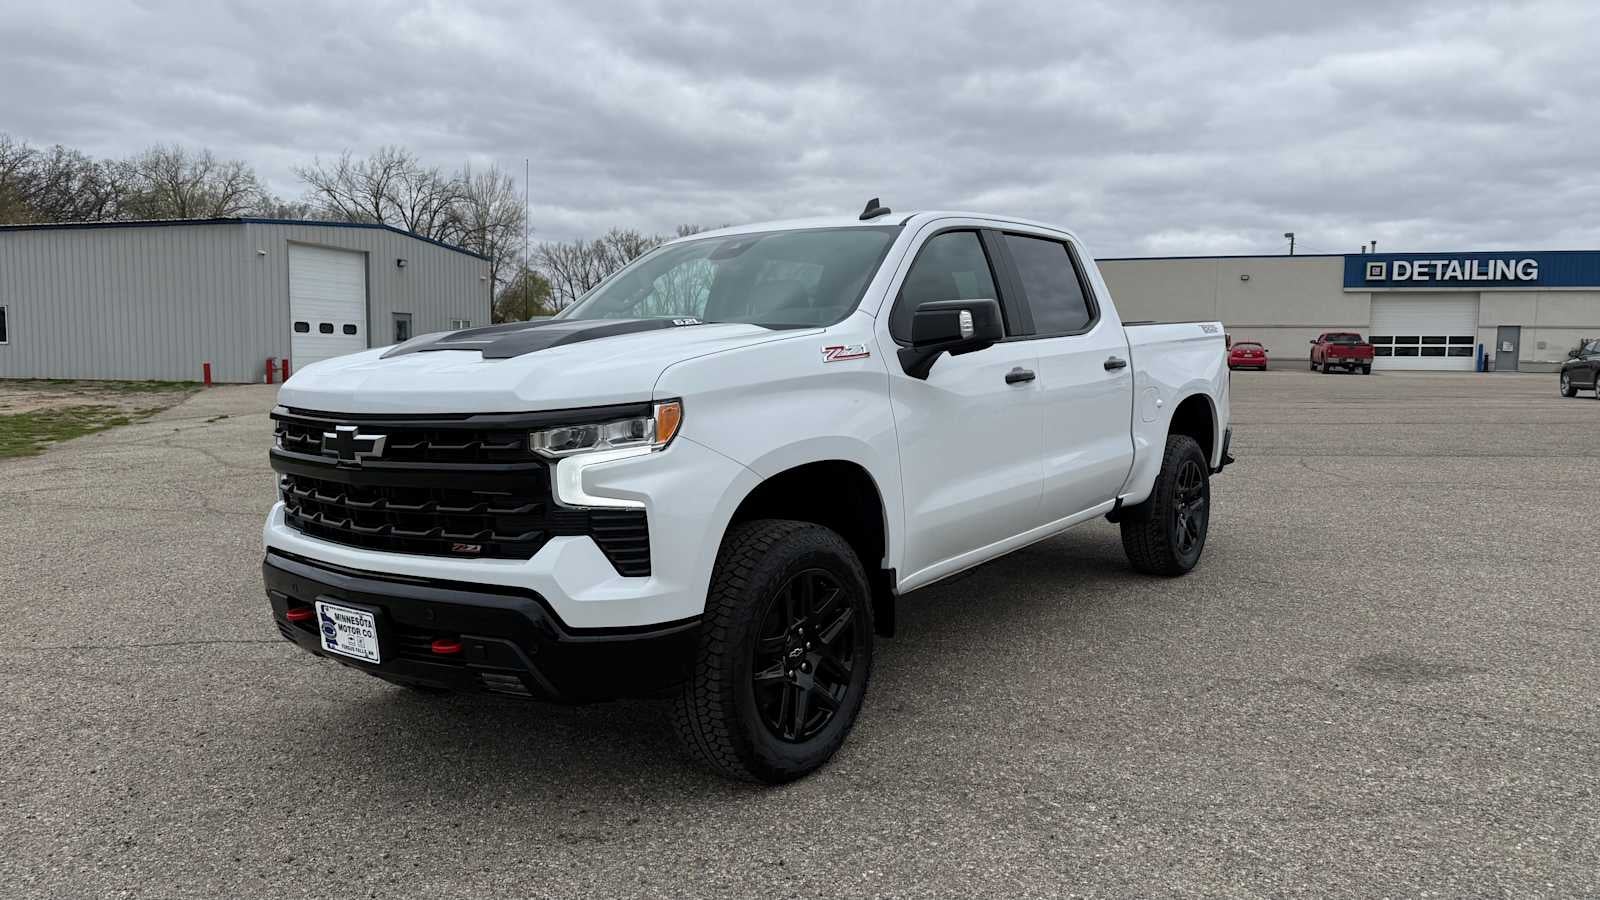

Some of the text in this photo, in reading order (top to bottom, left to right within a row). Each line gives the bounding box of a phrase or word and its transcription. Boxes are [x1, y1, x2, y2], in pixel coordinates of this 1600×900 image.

[1392, 259, 1538, 281] DETAILING
[821, 344, 871, 363] Z71
[334, 612, 372, 628] MINNESOTA
[338, 624, 361, 635] MOTOR
